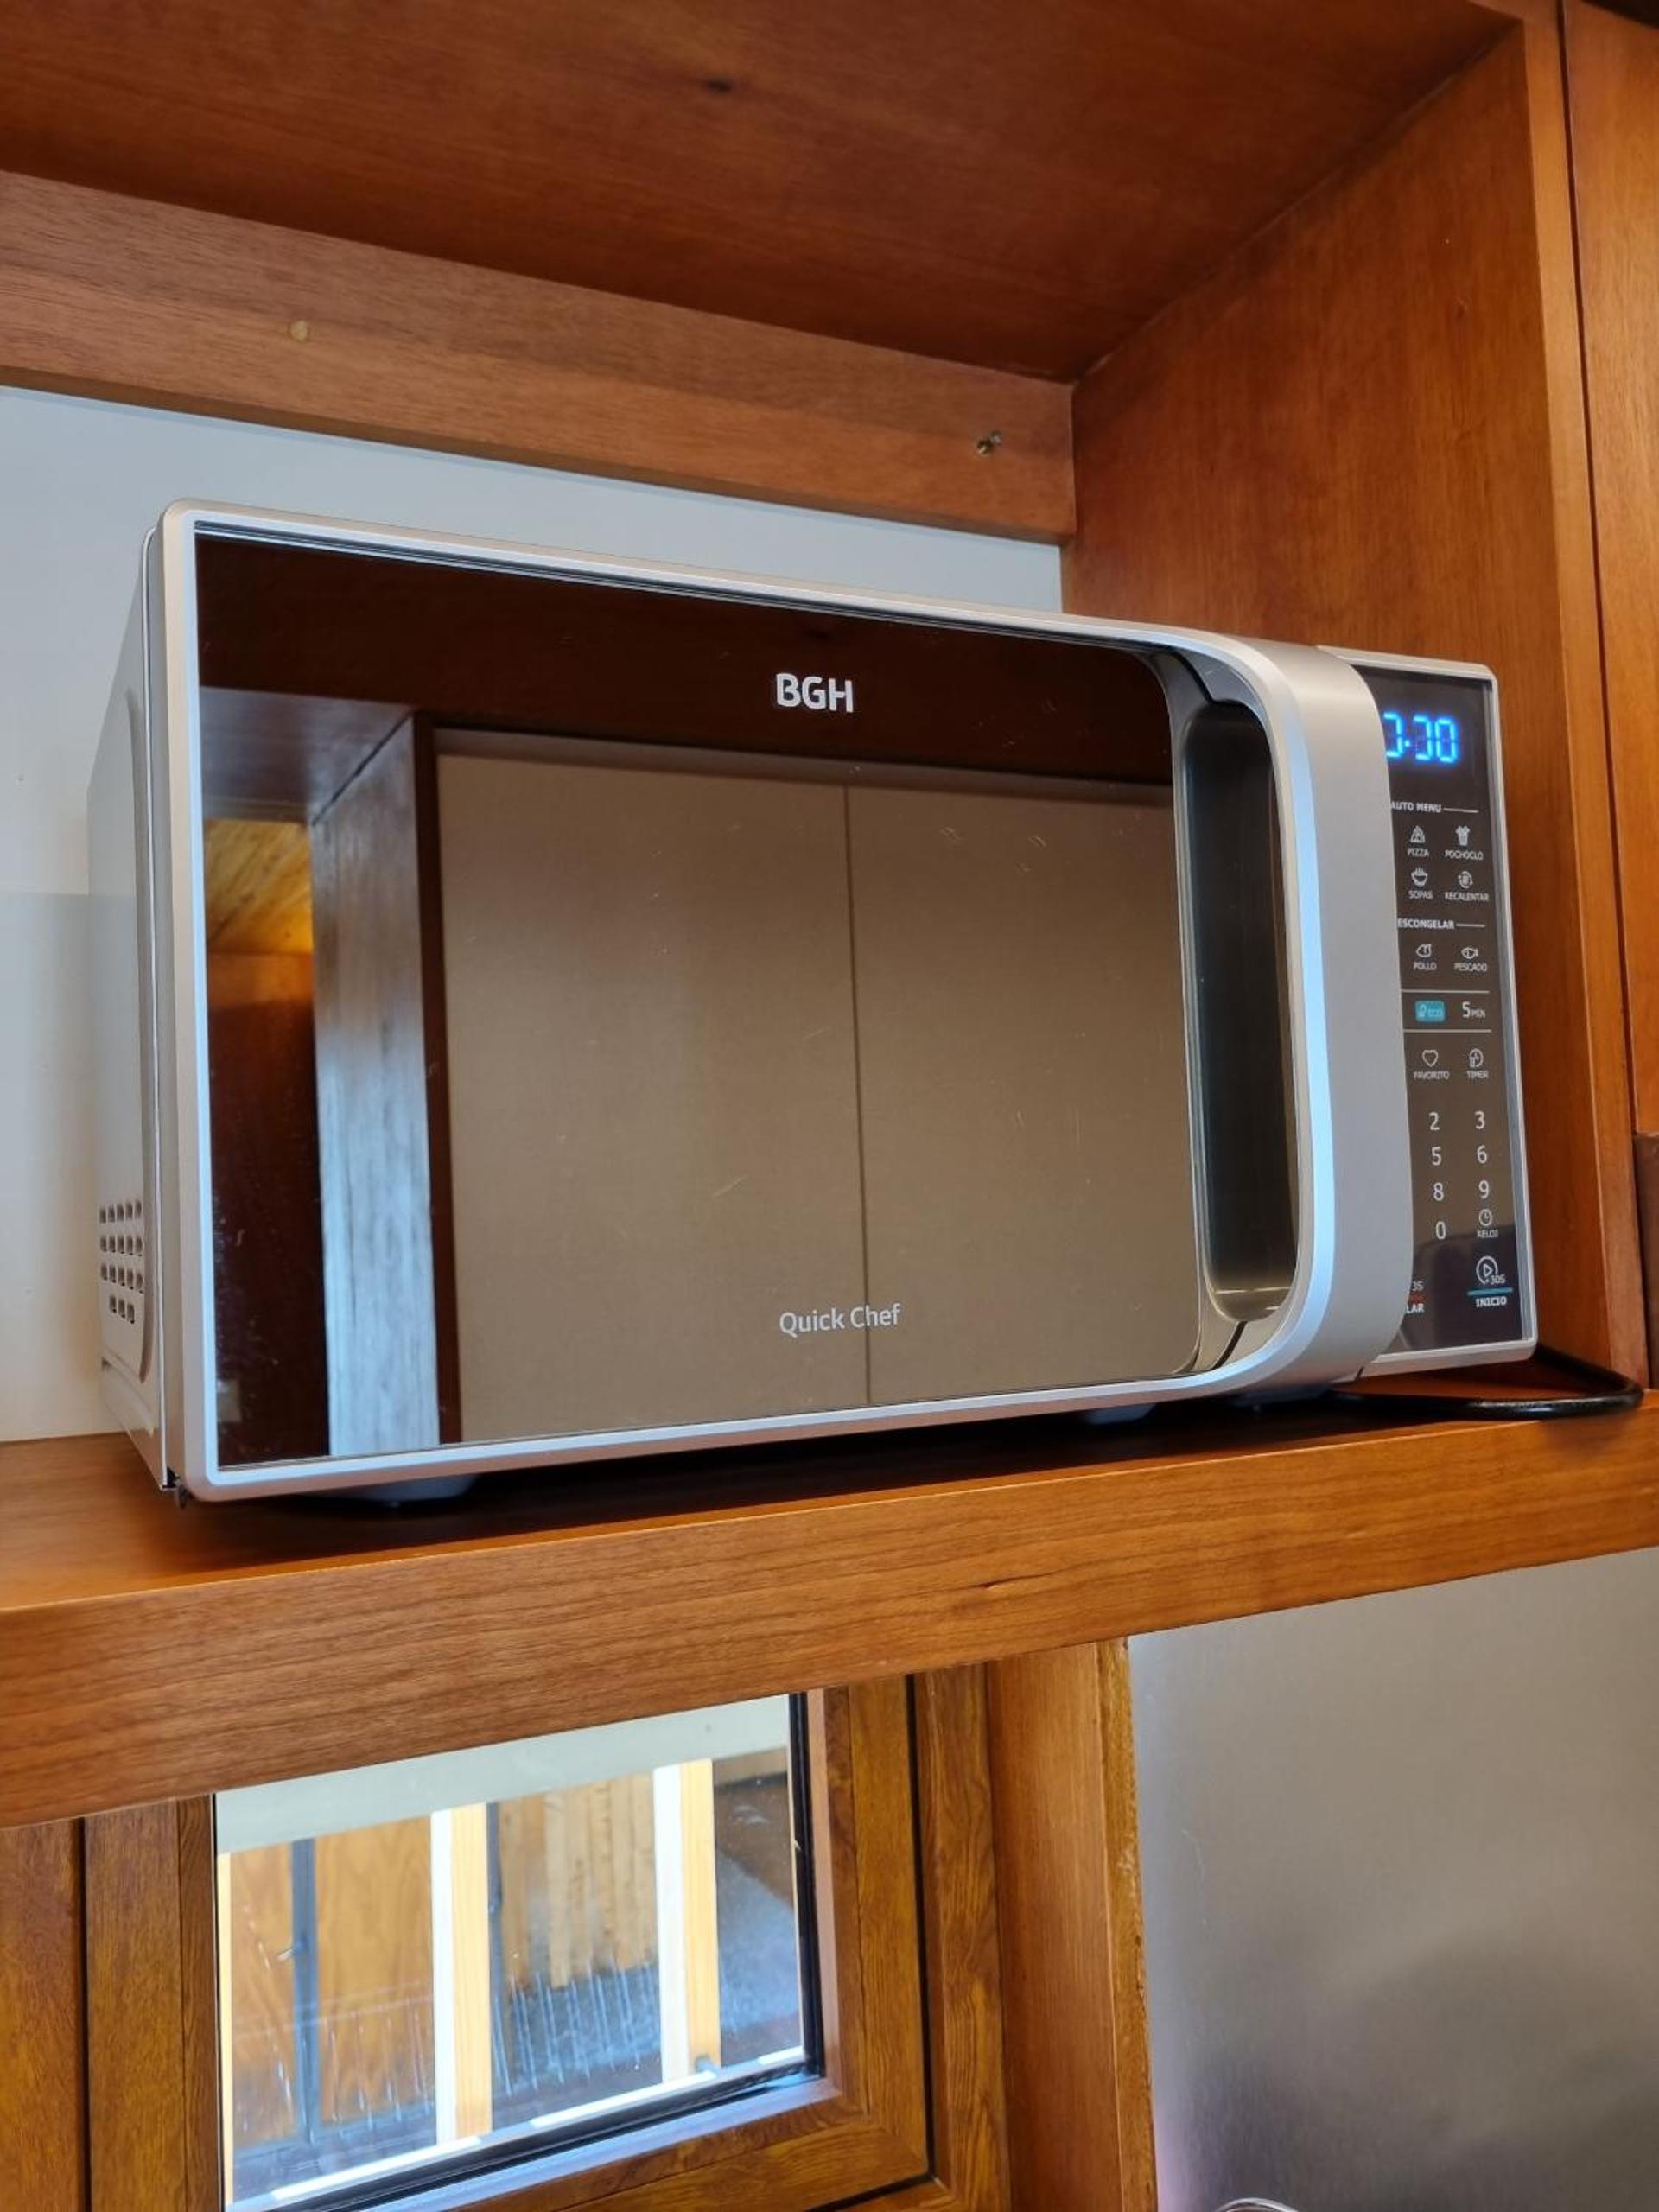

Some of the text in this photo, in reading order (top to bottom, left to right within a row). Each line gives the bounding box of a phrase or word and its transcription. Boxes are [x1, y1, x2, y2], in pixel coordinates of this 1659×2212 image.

[776, 672, 854, 714] BGH
[1391, 801, 1442, 813] AUTO MENU
[1408, 847, 1430, 858] PIZZA
[1408, 890, 1433, 899] SOPAS
[1445, 891, 1490, 901] RECALENTAR
[1413, 962, 1437, 971] POLLO
[1453, 962, 1488, 972] PESCADO
[1413, 1070, 1451, 1080] FAVORITO
[1466, 1070, 1489, 1079] TIMER
[1428, 1111, 1440, 1130] 2
[1475, 1110, 1485, 1130] 3
[1431, 1146, 1442, 1166] 5
[1477, 1144, 1488, 1164] 6
[1433, 1182, 1444, 1201] 8
[1478, 1179, 1490, 1199] 9
[1435, 1221, 1446, 1240] 0
[1475, 1296, 1508, 1307] INICIO
[779, 1303, 901, 1338] Quick Chef
